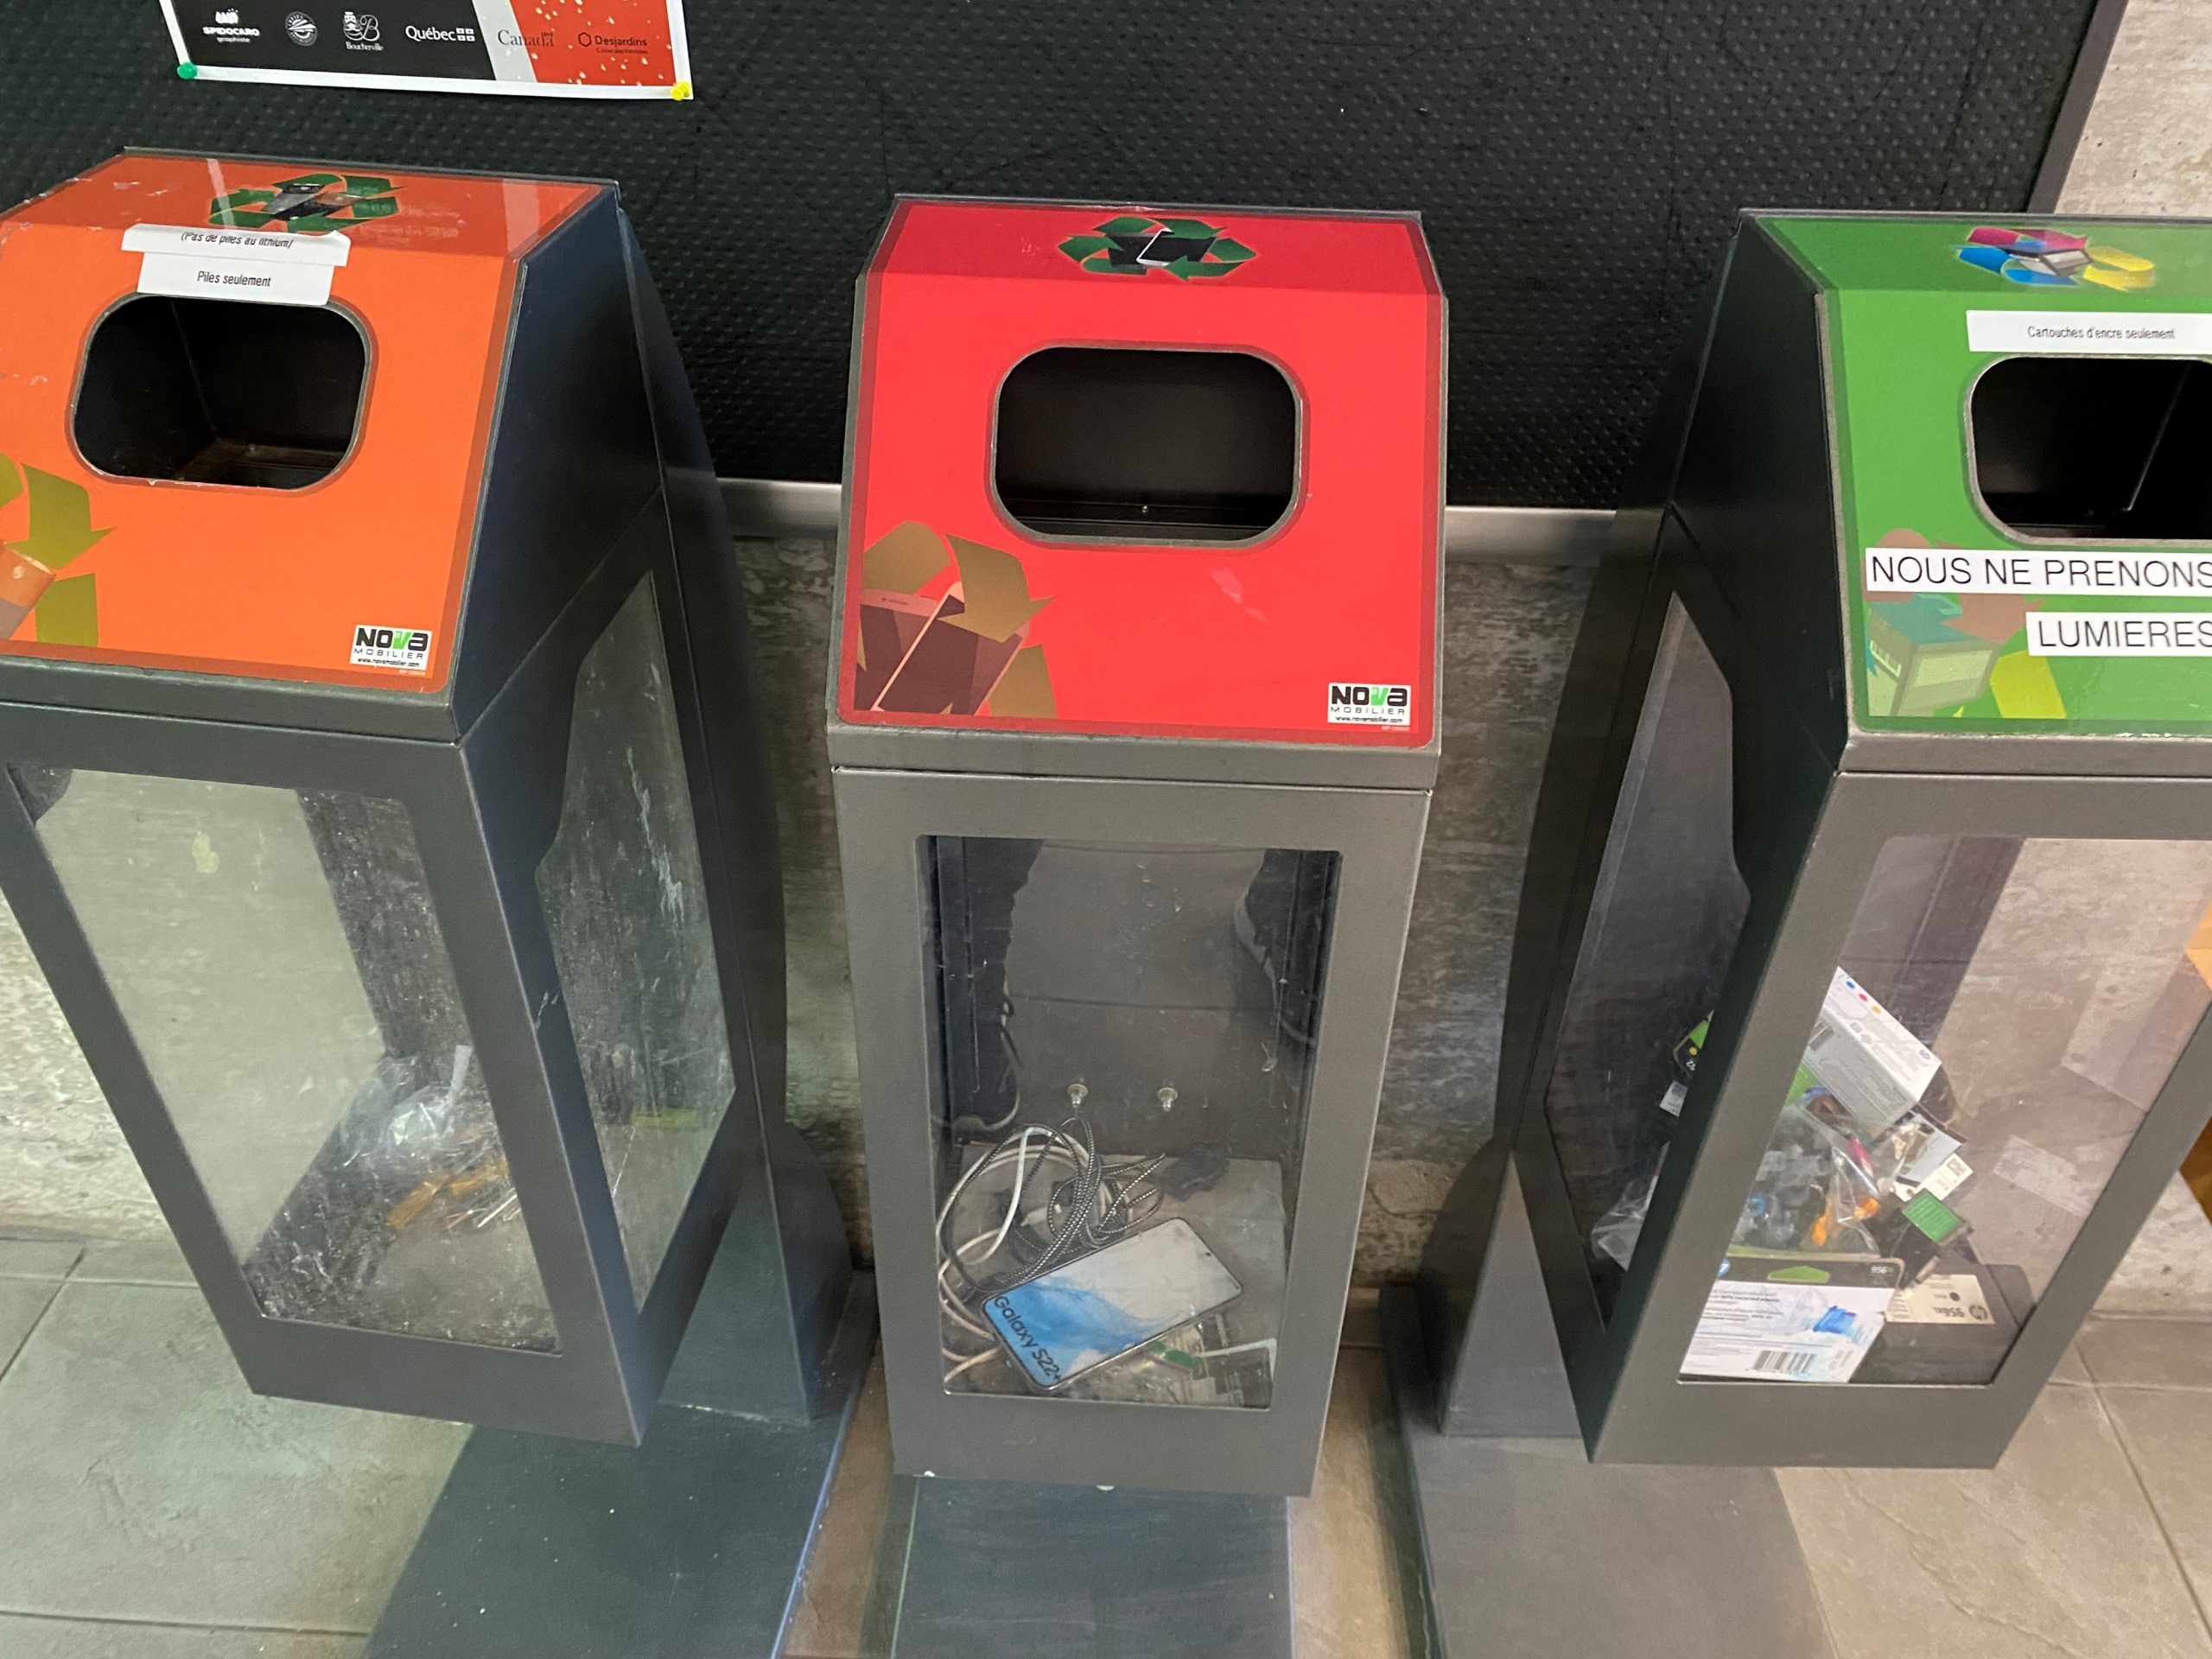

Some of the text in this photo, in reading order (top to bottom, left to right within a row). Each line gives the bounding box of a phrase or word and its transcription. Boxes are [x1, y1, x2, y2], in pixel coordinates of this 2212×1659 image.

[405, 25, 456, 42] Québec
[498, 29, 555, 48] Canada
[346, 41, 384, 51] Boucherville
[594, 35, 647, 48] Desjardins
[206, 233, 218, 243] de
[219, 234, 242, 245] piles
[245, 237, 256, 245] au
[197, 270, 271, 287] Piles seulement
[2028, 326, 2176, 340] Cartouches d'encre seulement
[1872, 556, 2212, 588] NOUS NE PRENONS
[2038, 620, 2212, 648] LUMIERES
[354, 648, 423, 659] MOBILIER
[357, 658, 420, 668] www.novamobilier.com
[1331, 707, 1405, 715] MOBILIER
[995, 1296, 1062, 1381] Galaxy S22+
